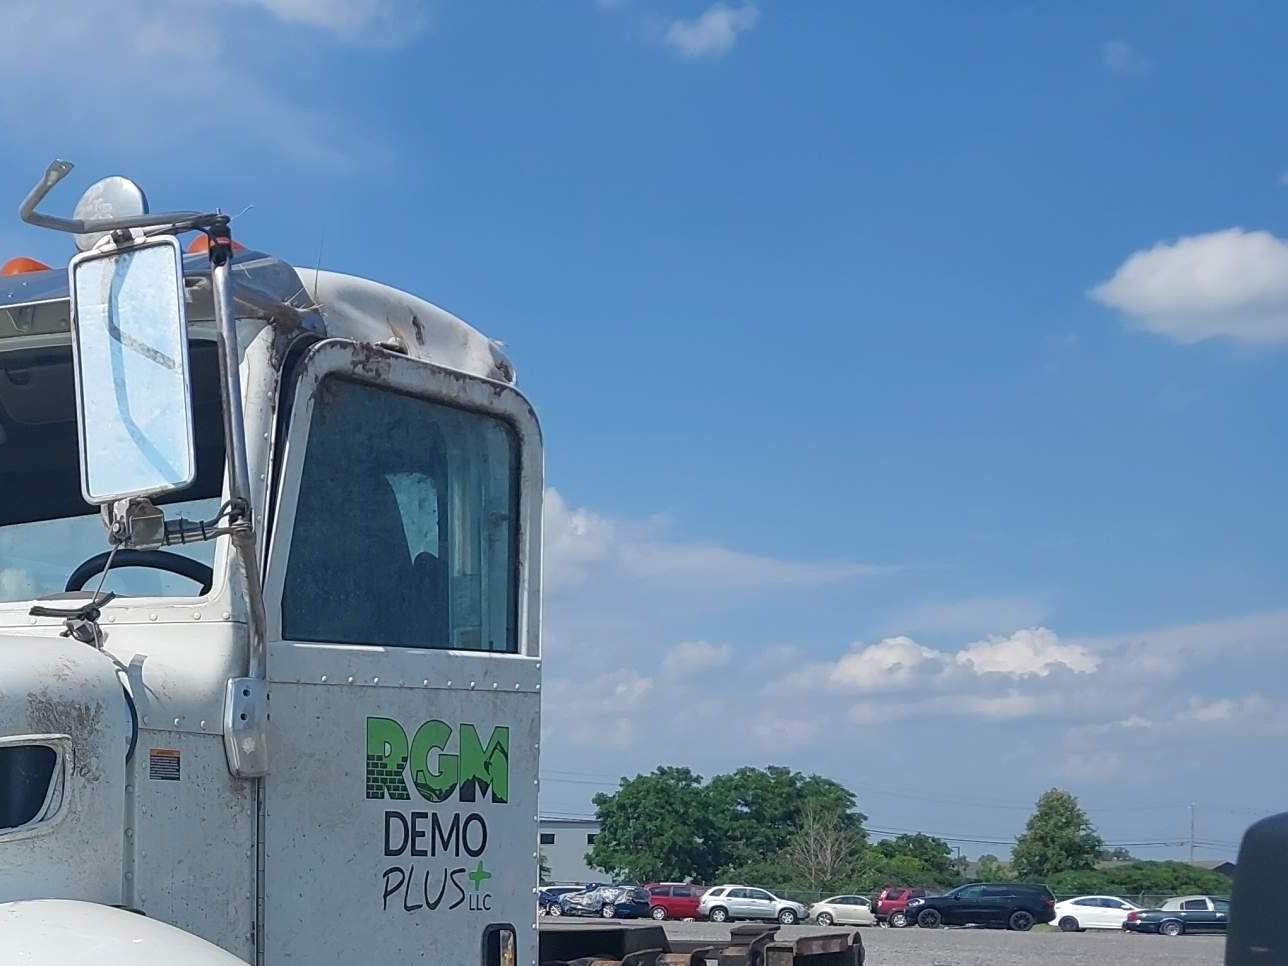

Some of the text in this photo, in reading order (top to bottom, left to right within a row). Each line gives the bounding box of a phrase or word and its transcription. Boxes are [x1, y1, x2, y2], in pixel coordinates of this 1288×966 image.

[365, 716, 510, 805] RGM
[383, 811, 488, 858] DEMO
[469, 894, 492, 911] LLC
